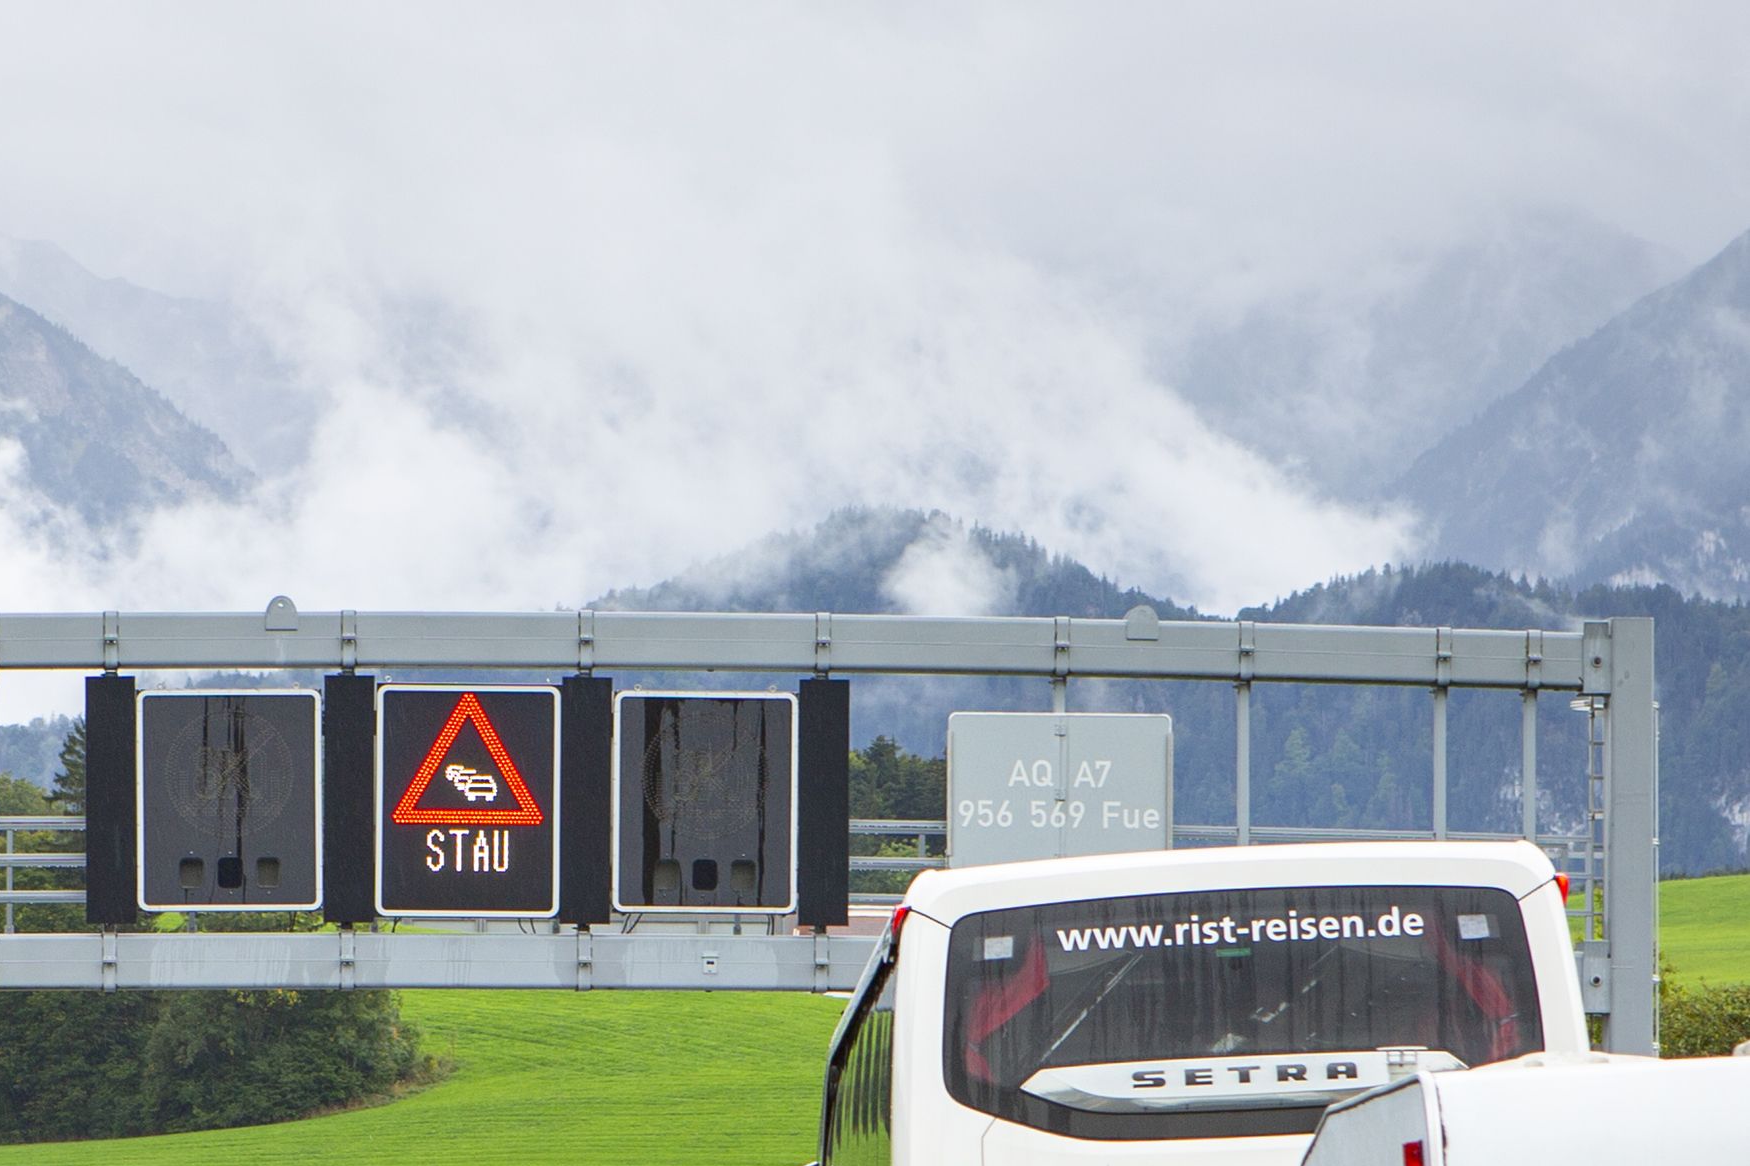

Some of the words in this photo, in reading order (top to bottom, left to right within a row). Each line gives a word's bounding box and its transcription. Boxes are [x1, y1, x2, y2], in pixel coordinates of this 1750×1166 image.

[1008, 759, 1054, 787] AQ
[1073, 760, 1112, 787] A7
[958, 800, 1013, 828] 956
[1030, 800, 1086, 828] 569
[1102, 801, 1160, 829] Fue
[426, 829, 509, 872] STAU
[1056, 905, 1425, 952] www.rist-reisen.de
[1131, 1061, 1359, 1089] SETRA
